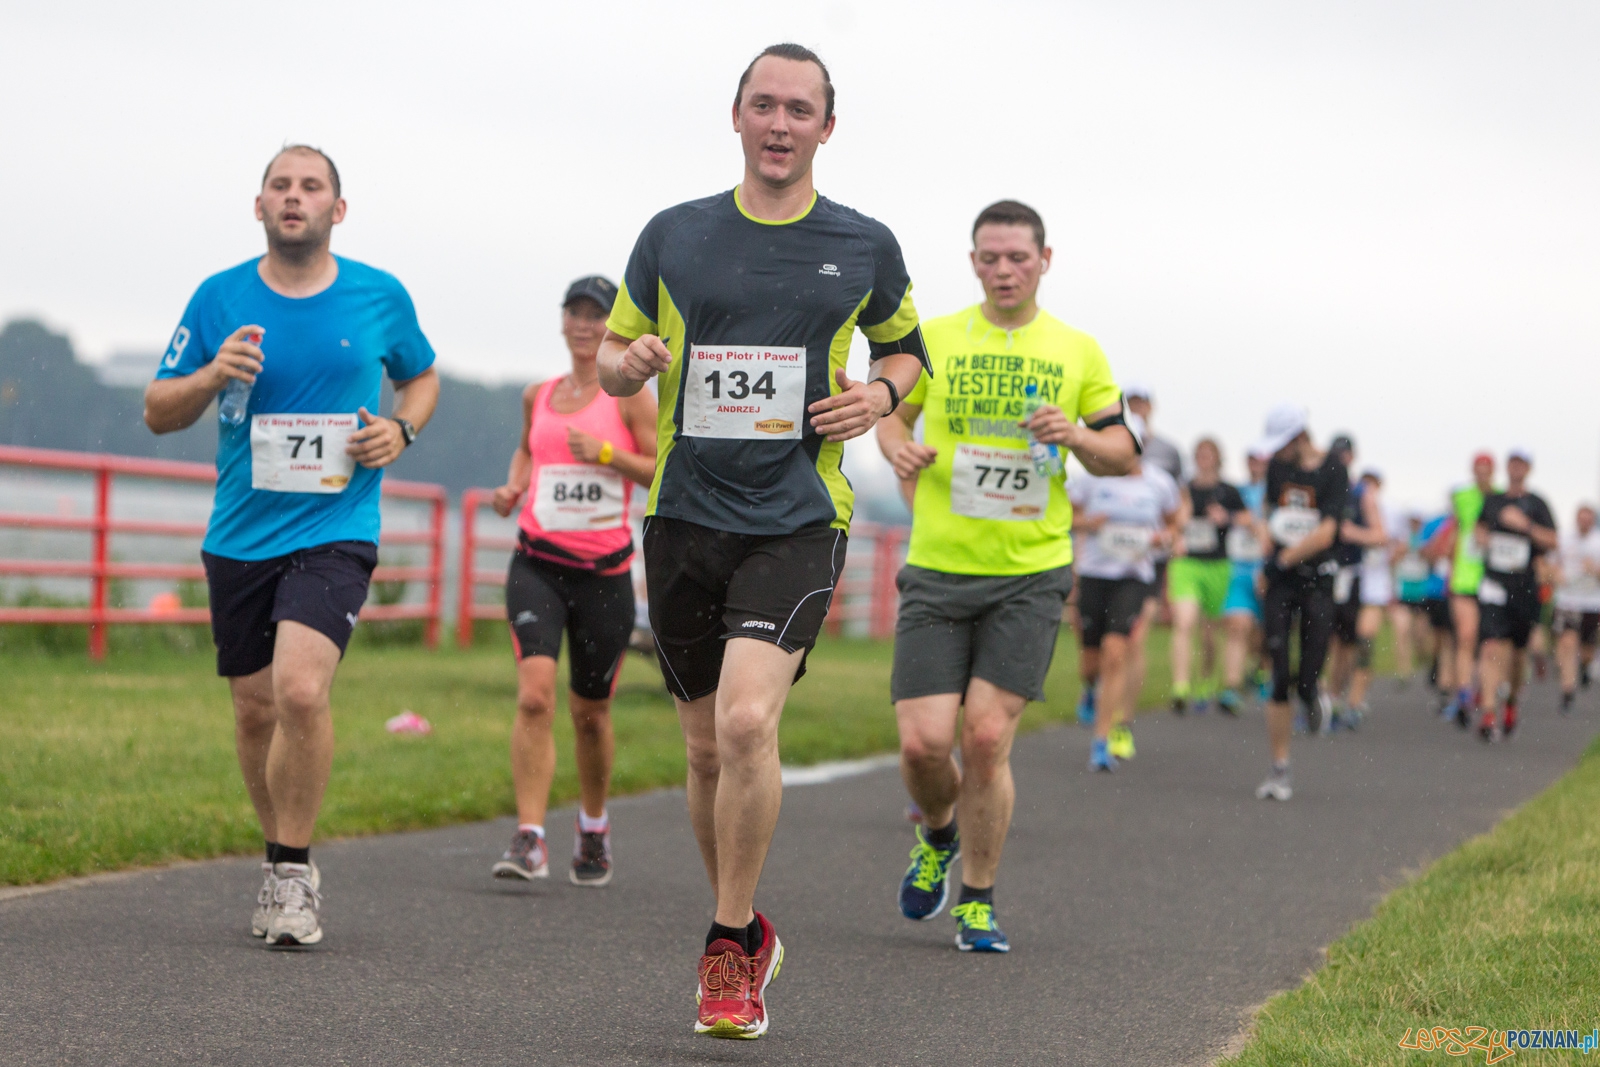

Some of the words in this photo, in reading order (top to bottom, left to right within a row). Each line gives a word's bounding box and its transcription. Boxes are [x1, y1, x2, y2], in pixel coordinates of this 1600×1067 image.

[165, 326, 191, 369] 9
[697, 351, 723, 362] Bieg
[726, 351, 754, 360] Piotr
[757, 352, 760, 361] i
[764, 352, 799, 362] Paweł
[945, 355, 966, 371] I'M
[971, 354, 1025, 372] BETTER
[1028, 357, 1065, 378] THAN
[705, 370, 776, 400] 134
[717, 405, 760, 413] ANDRZEJ
[945, 398, 968, 414] BUT
[973, 399, 1000, 415] NOT
[1003, 400, 1023, 416] AS
[948, 418, 964, 435] AS
[287, 435, 323, 459] 71
[974, 464, 1030, 491] 775
[553, 482, 602, 502] 848
